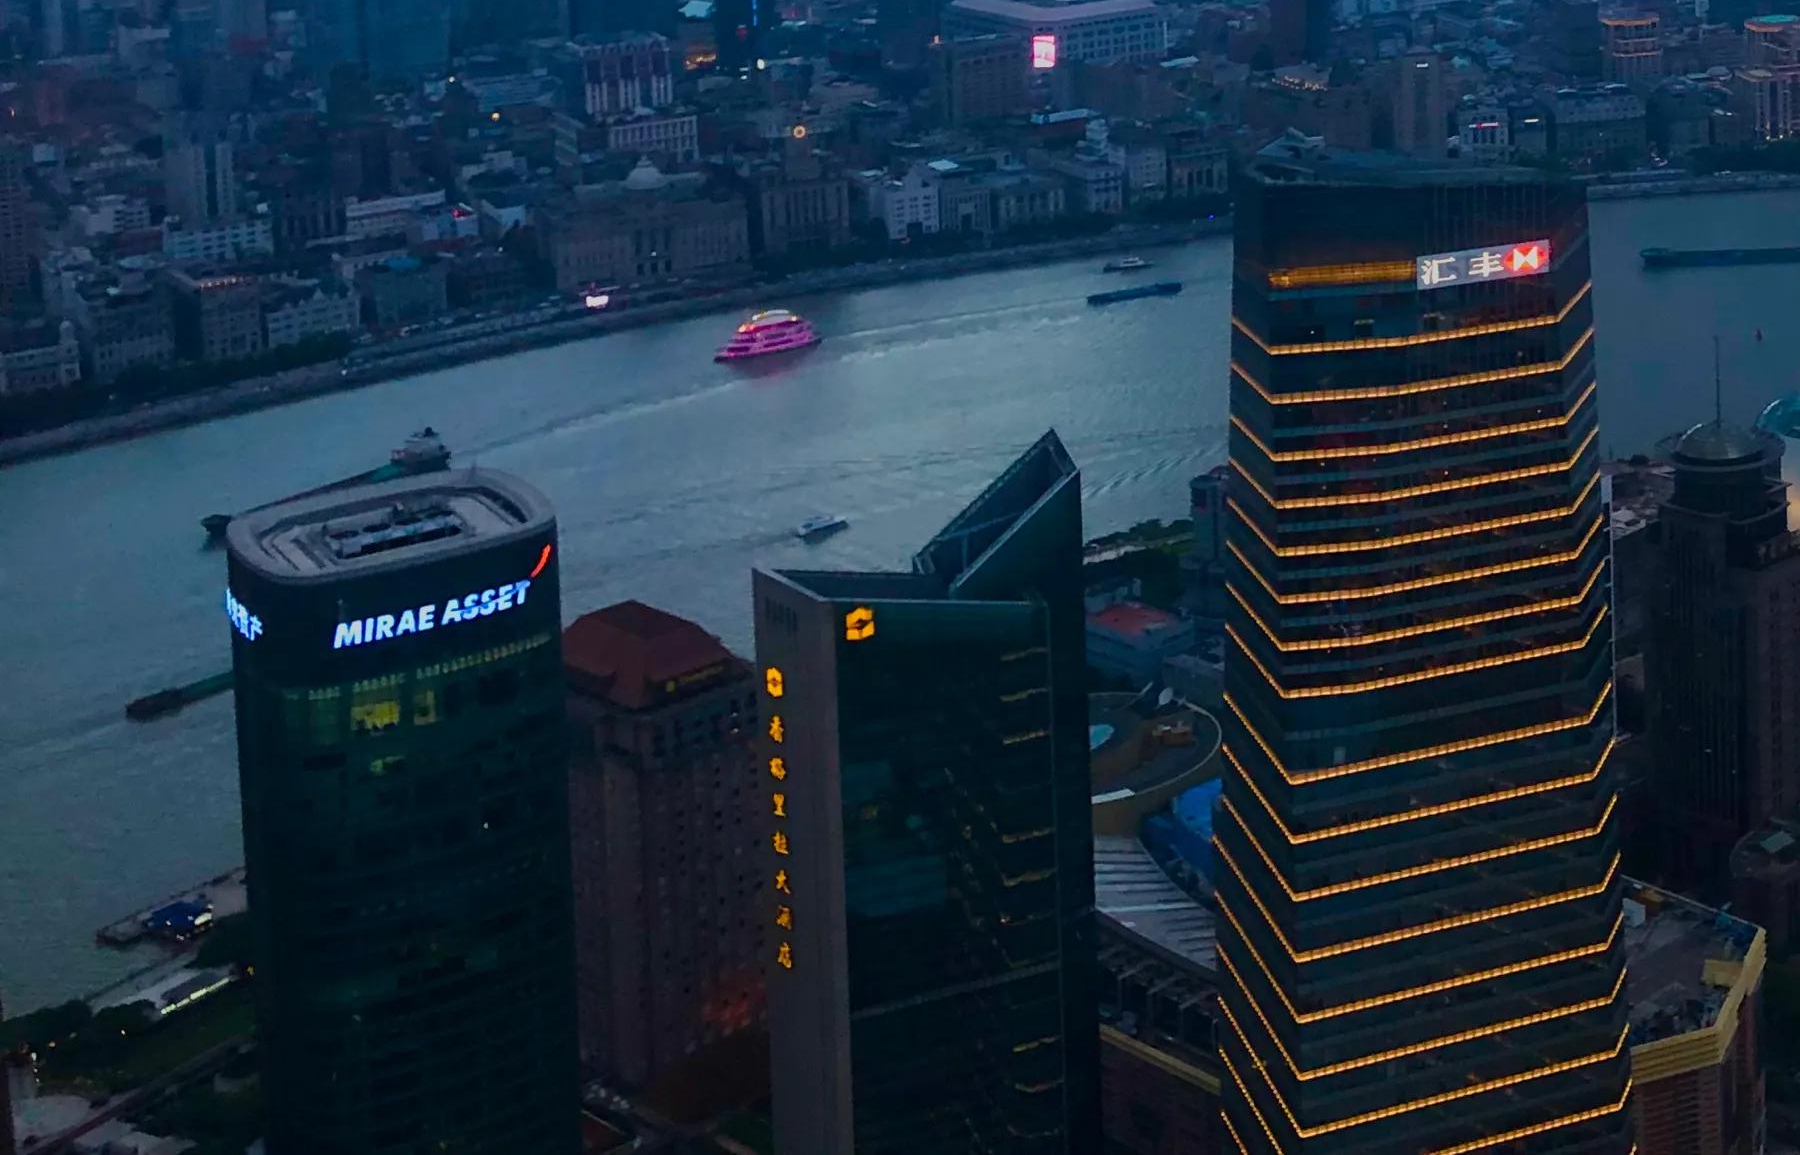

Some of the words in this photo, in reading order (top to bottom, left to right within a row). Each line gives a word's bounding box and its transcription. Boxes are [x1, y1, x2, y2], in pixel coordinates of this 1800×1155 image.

[1420, 251, 1505, 285] 汇丰
[333, 603, 436, 649] MIRAE
[441, 579, 531, 626] ASSET
[768, 714, 793, 969] 香格里拉大酒店
